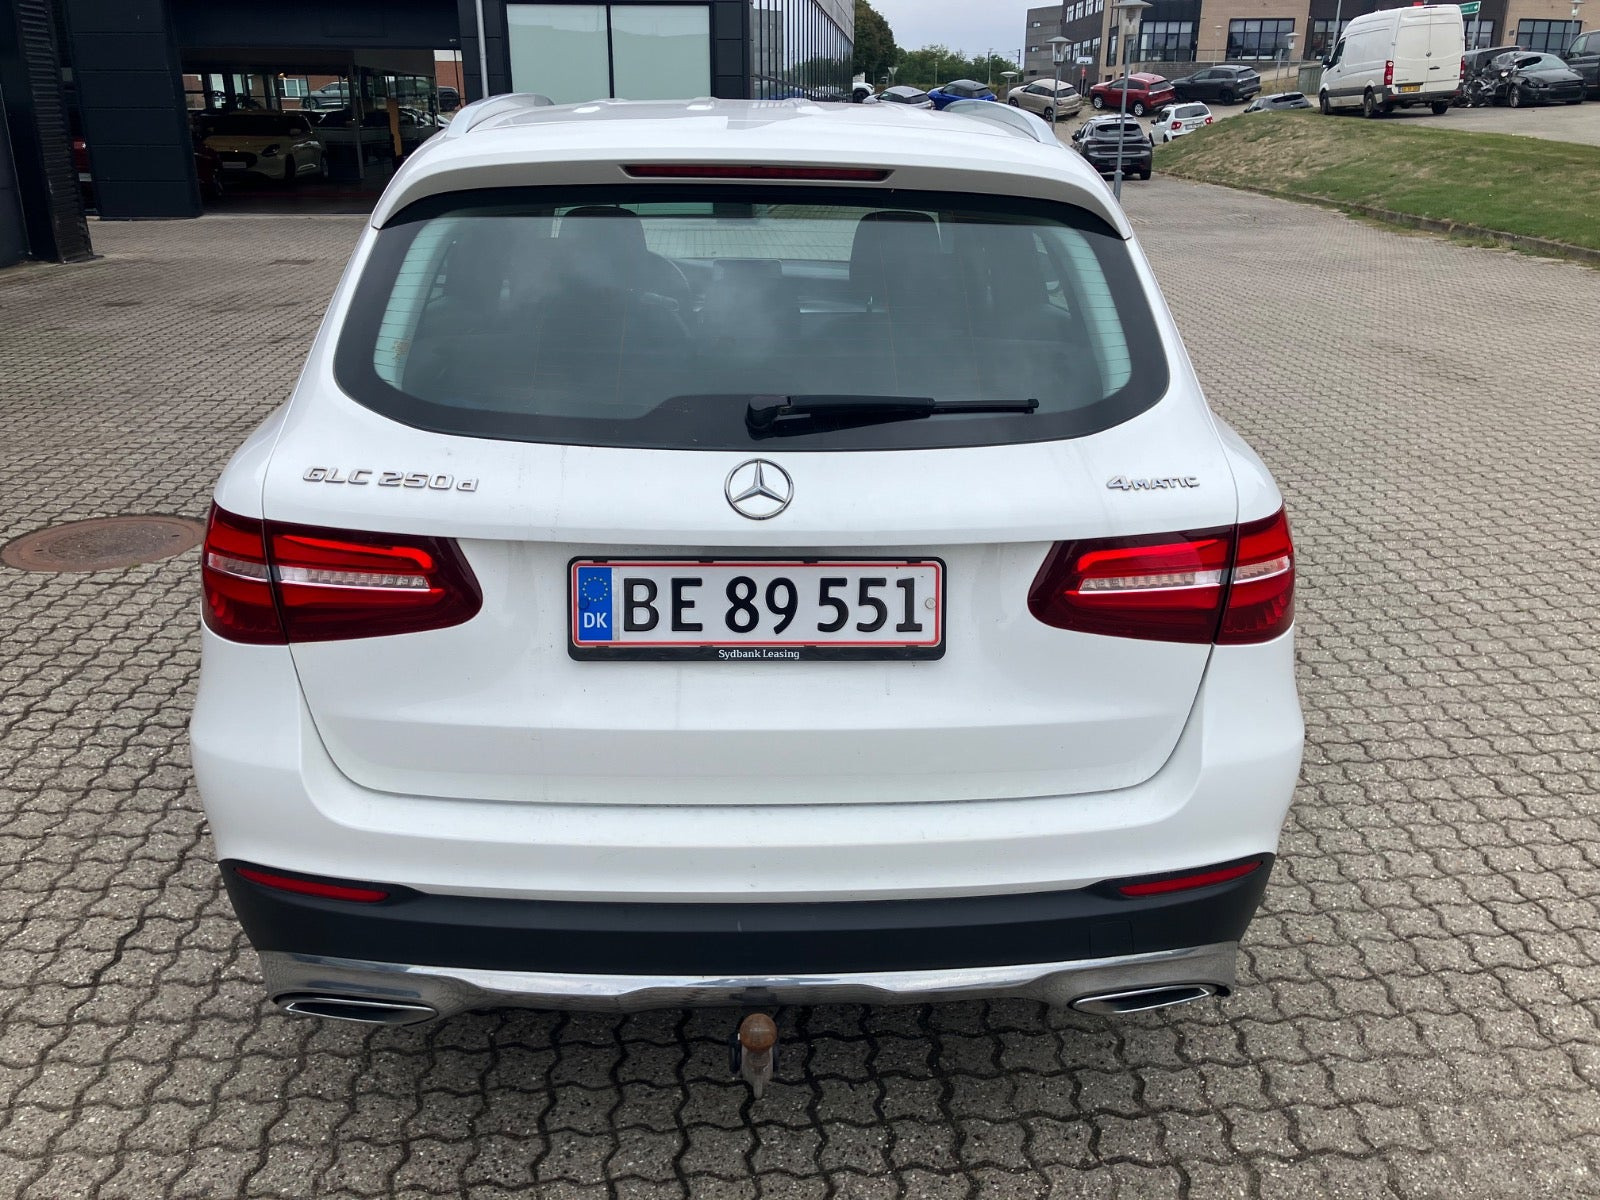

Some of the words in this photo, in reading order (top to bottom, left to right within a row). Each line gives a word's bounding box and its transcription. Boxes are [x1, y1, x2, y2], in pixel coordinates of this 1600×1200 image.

[302, 466, 373, 485] GLC
[1106, 475, 1200, 491] 4MATIC
[623, 577, 703, 633] BE
[724, 575, 799, 635] 89
[817, 577, 923, 633] 551
[583, 612, 608, 629] DK
[718, 649, 761, 660] Sydbank
[763, 649, 800, 660] Leasing
